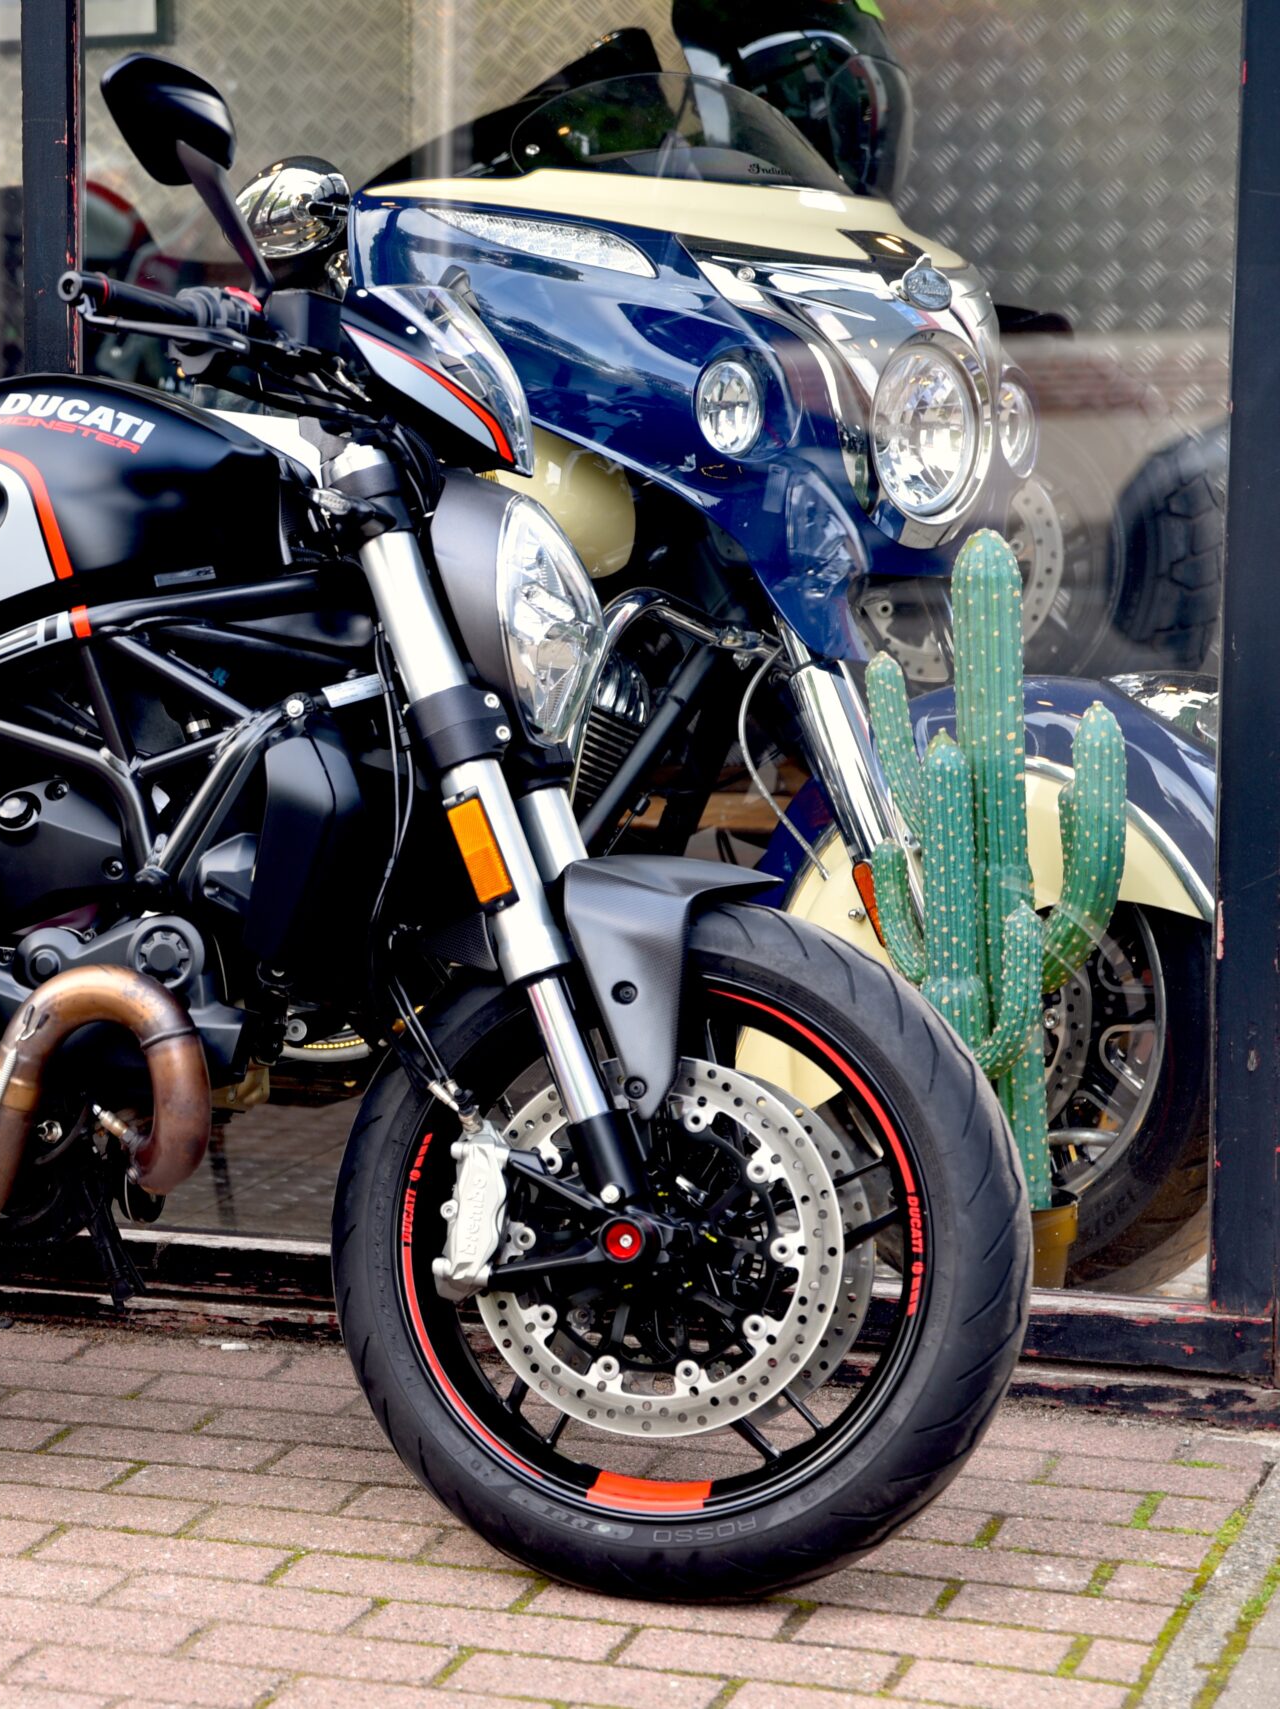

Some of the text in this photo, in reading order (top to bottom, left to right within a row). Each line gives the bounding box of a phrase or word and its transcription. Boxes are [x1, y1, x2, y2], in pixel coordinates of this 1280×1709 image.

[400, 1187, 416, 1243] DUCATI
[458, 1175, 488, 1256] brembo
[906, 1195, 924, 1255] DUCATI
[652, 1515, 758, 1544] ROSSO
